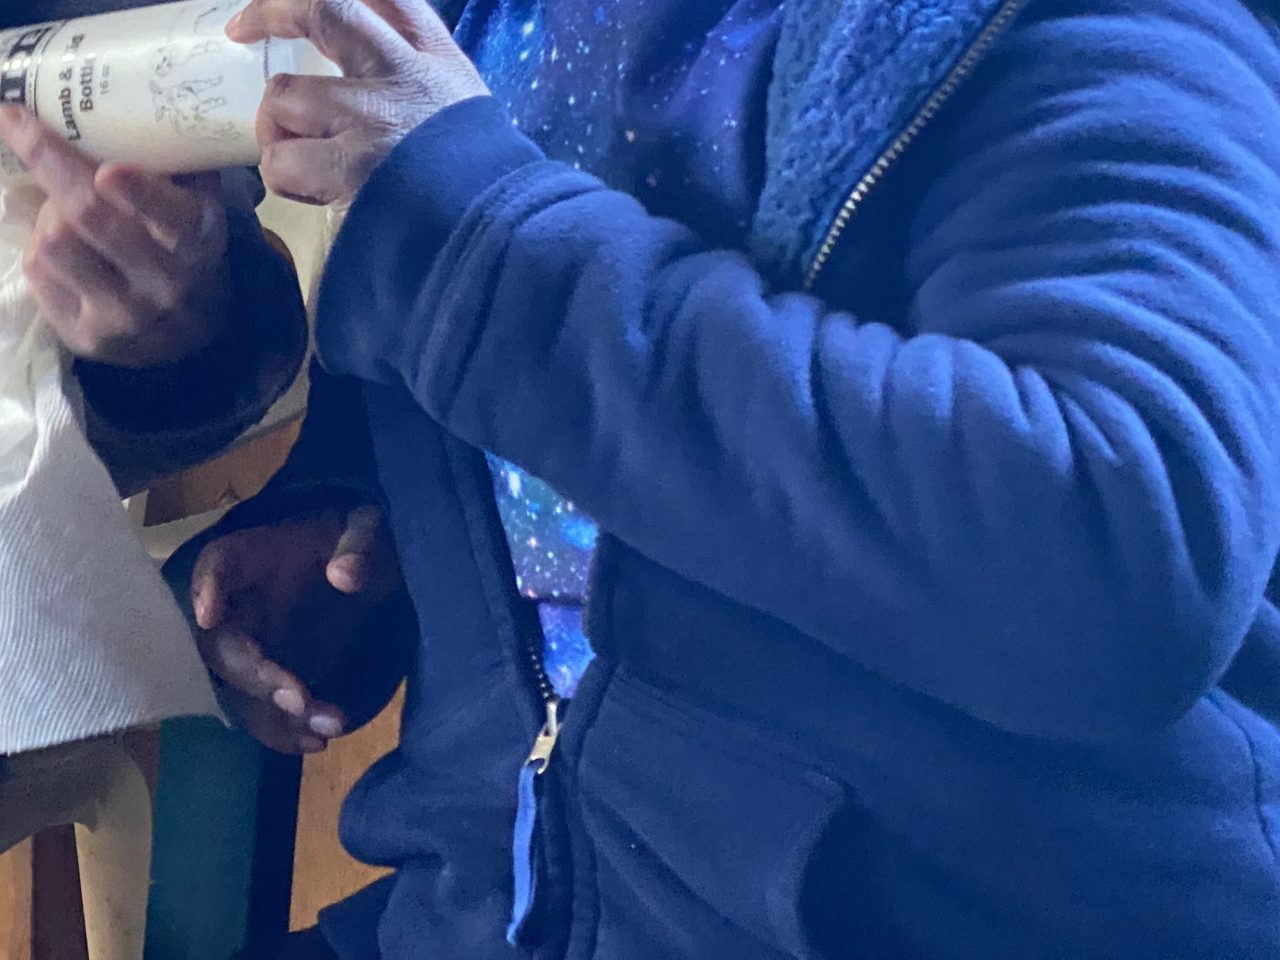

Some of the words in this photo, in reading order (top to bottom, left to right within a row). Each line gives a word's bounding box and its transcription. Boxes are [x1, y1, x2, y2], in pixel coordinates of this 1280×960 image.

[58, 66, 73, 81] &
[100, 80, 109, 95] 16
[58, 87, 81, 140] Lamb
